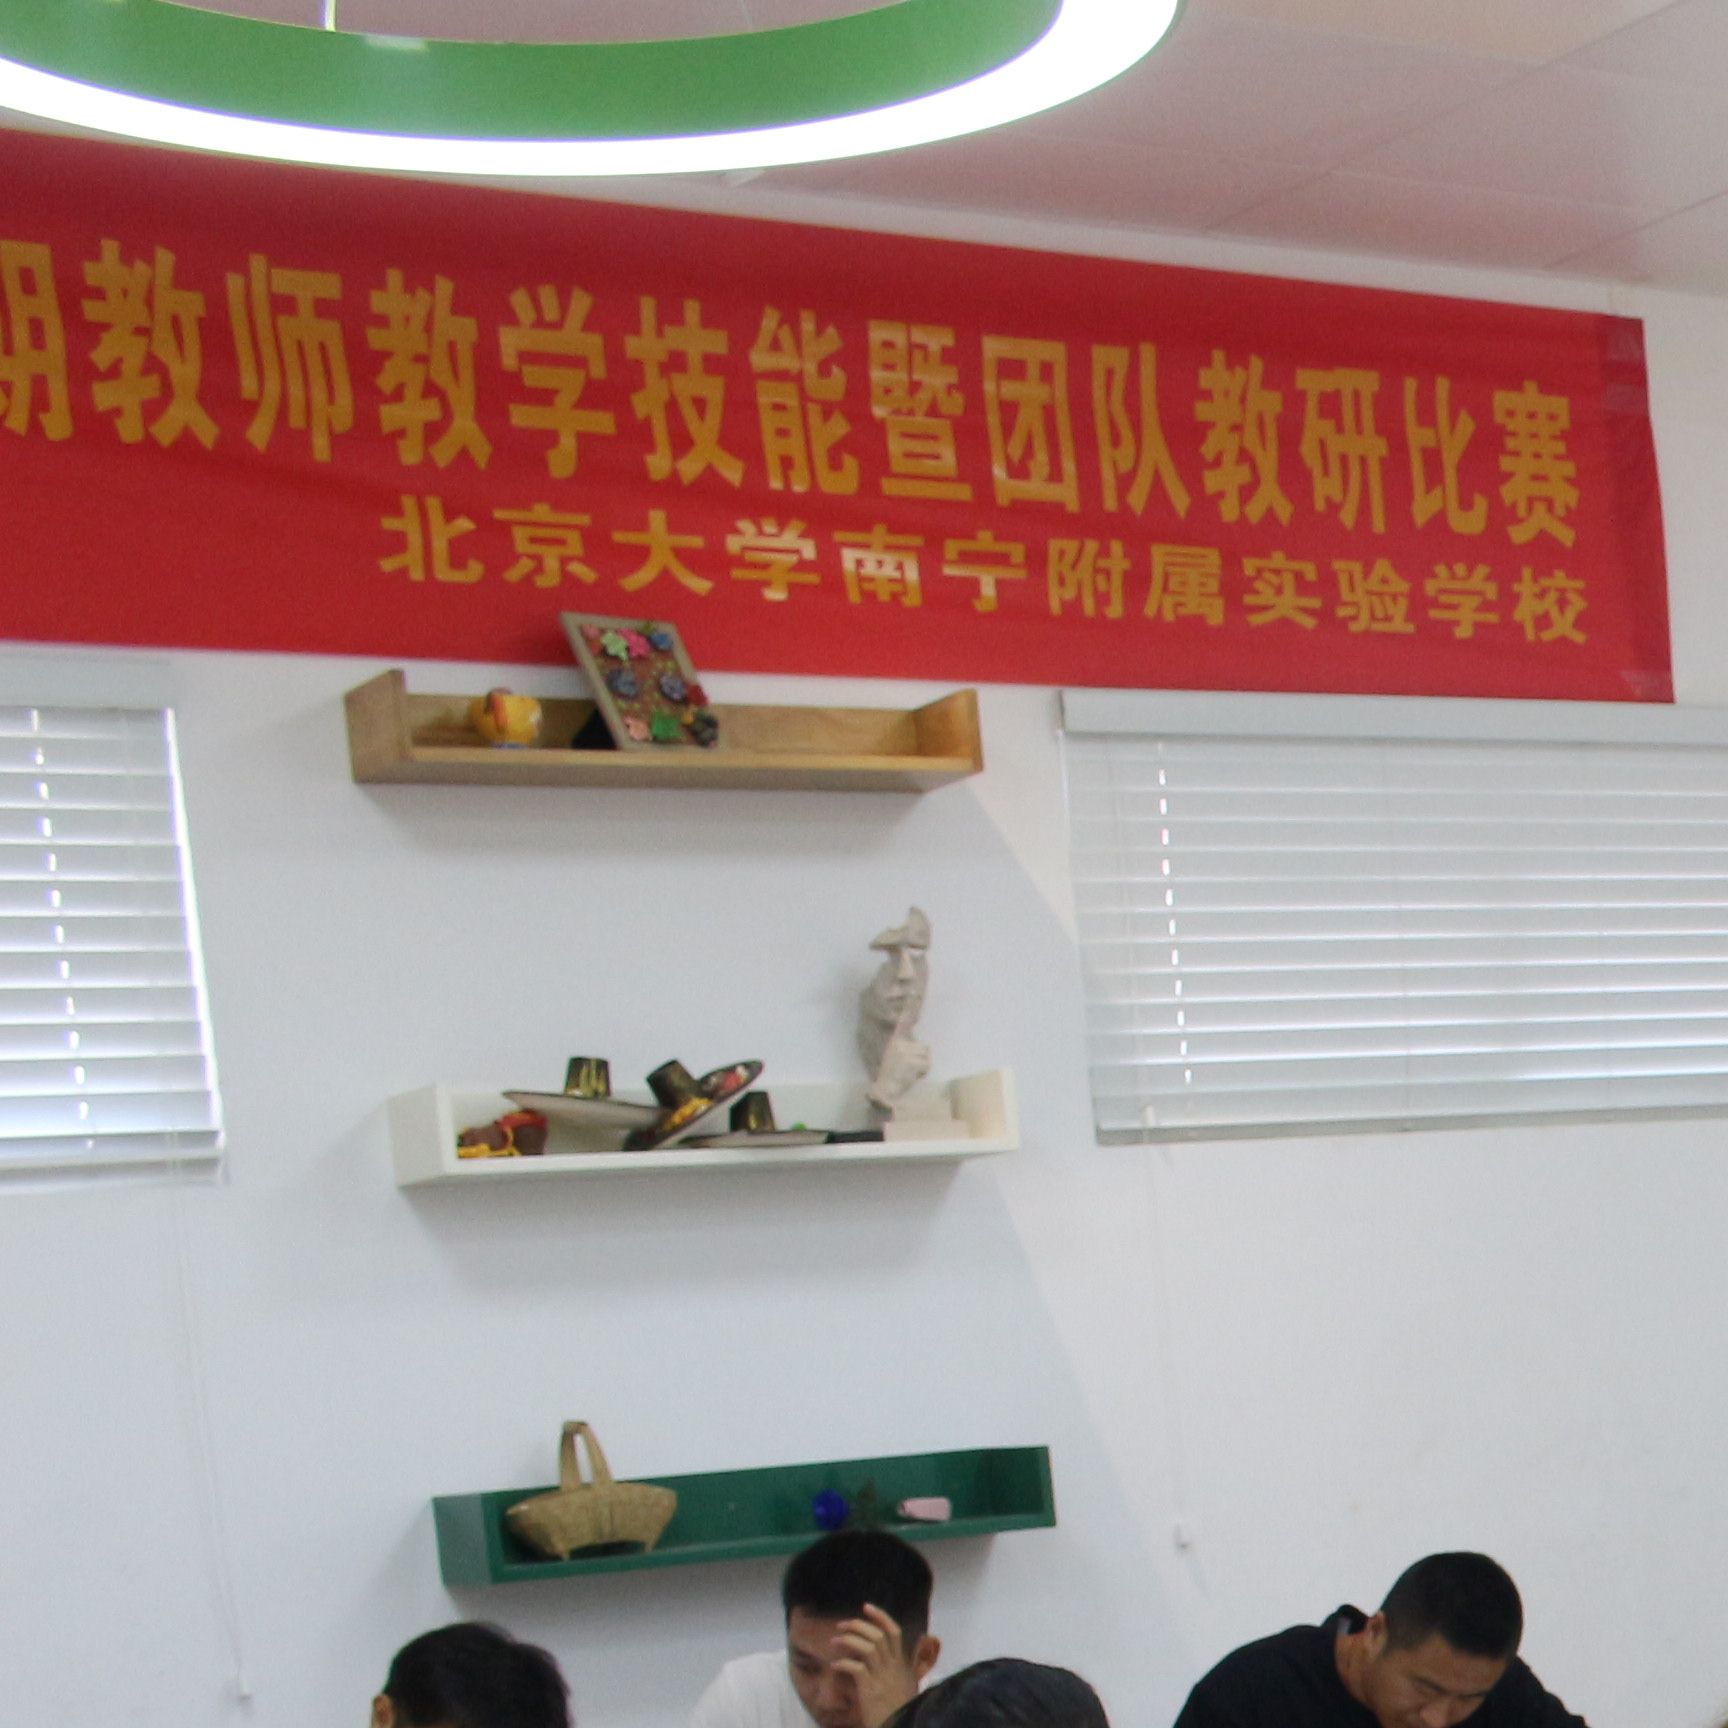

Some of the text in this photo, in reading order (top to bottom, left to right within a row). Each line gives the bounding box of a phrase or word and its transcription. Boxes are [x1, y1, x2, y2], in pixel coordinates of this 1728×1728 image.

[379, 495, 1588, 644] 北京大学南宁附属实验学校
